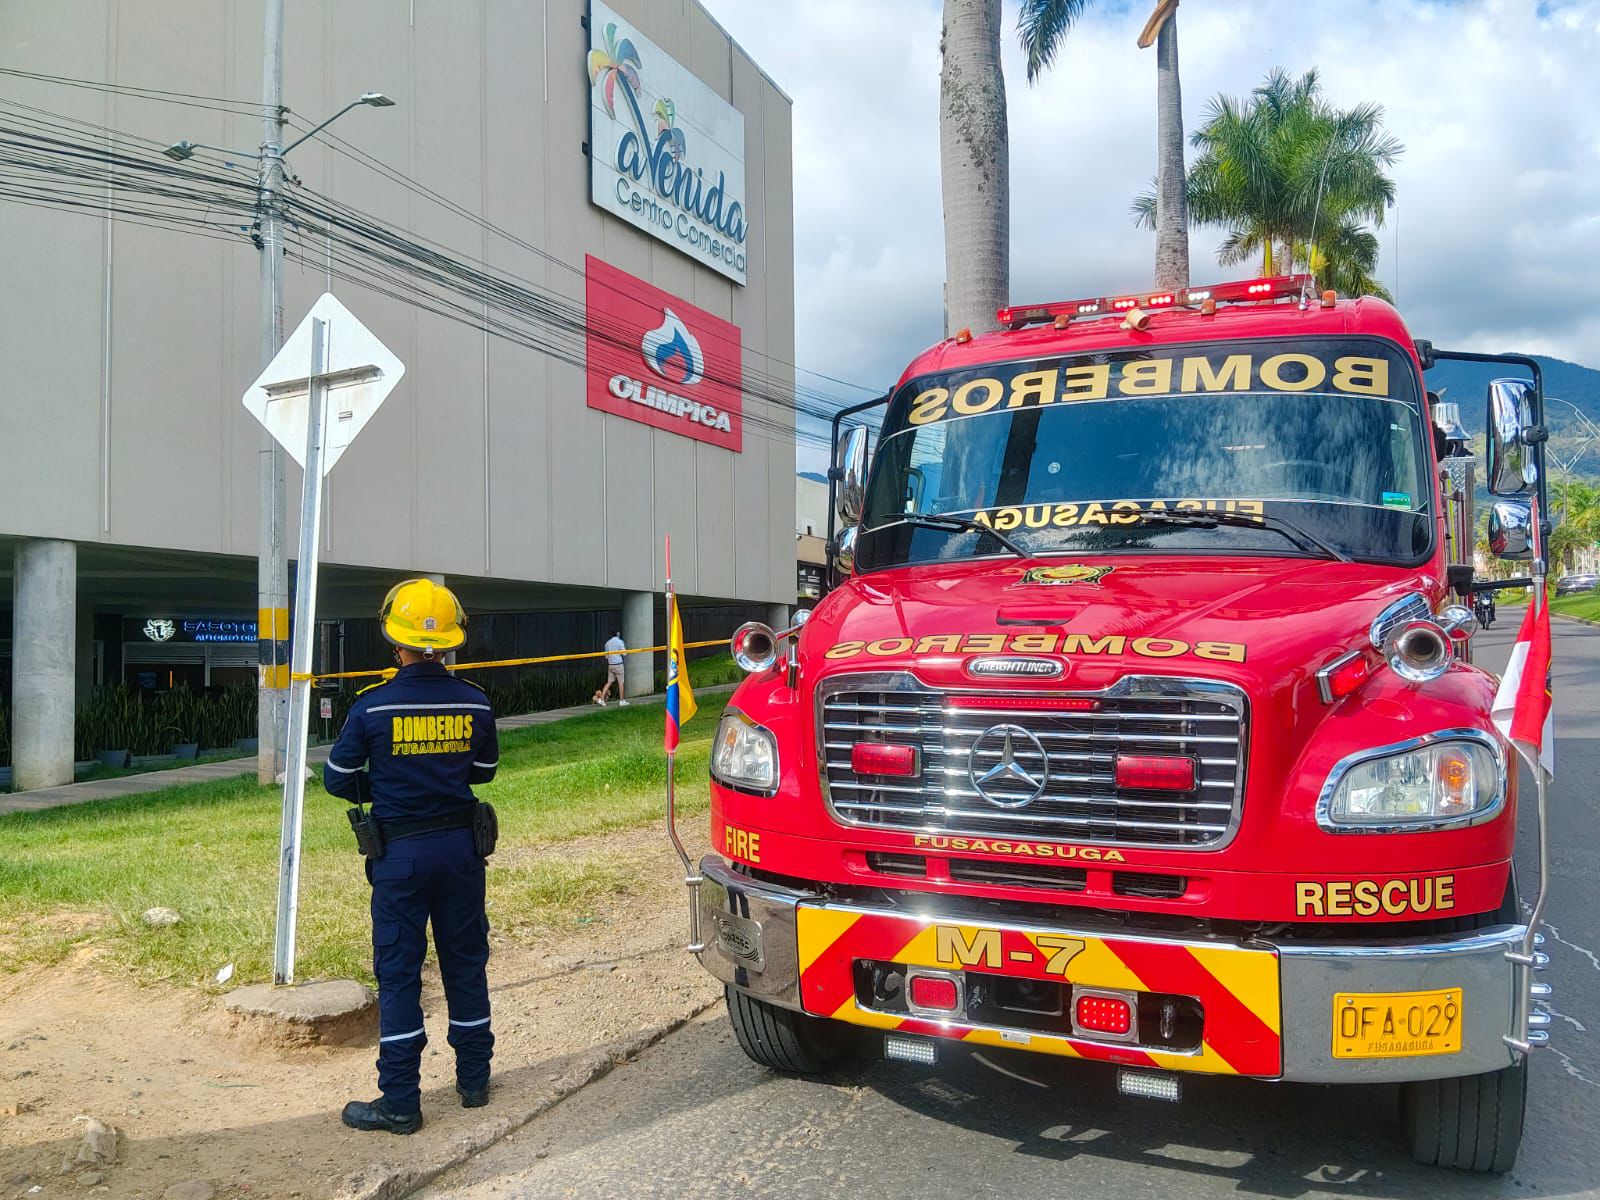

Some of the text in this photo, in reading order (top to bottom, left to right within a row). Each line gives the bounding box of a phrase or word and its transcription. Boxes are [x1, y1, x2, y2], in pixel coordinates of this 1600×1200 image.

[616, 177, 673, 231] Centro
[608, 374, 731, 433] OLIMPICA
[977, 661, 1053, 673] FREIGHTLINER
[392, 715, 473, 742] BOMBEROS
[725, 824, 761, 864] FIRE
[912, 835, 1126, 863] FUSAGASUGA
[1295, 874, 1456, 917] RESCUE
[935, 925, 1087, 976] M-7
